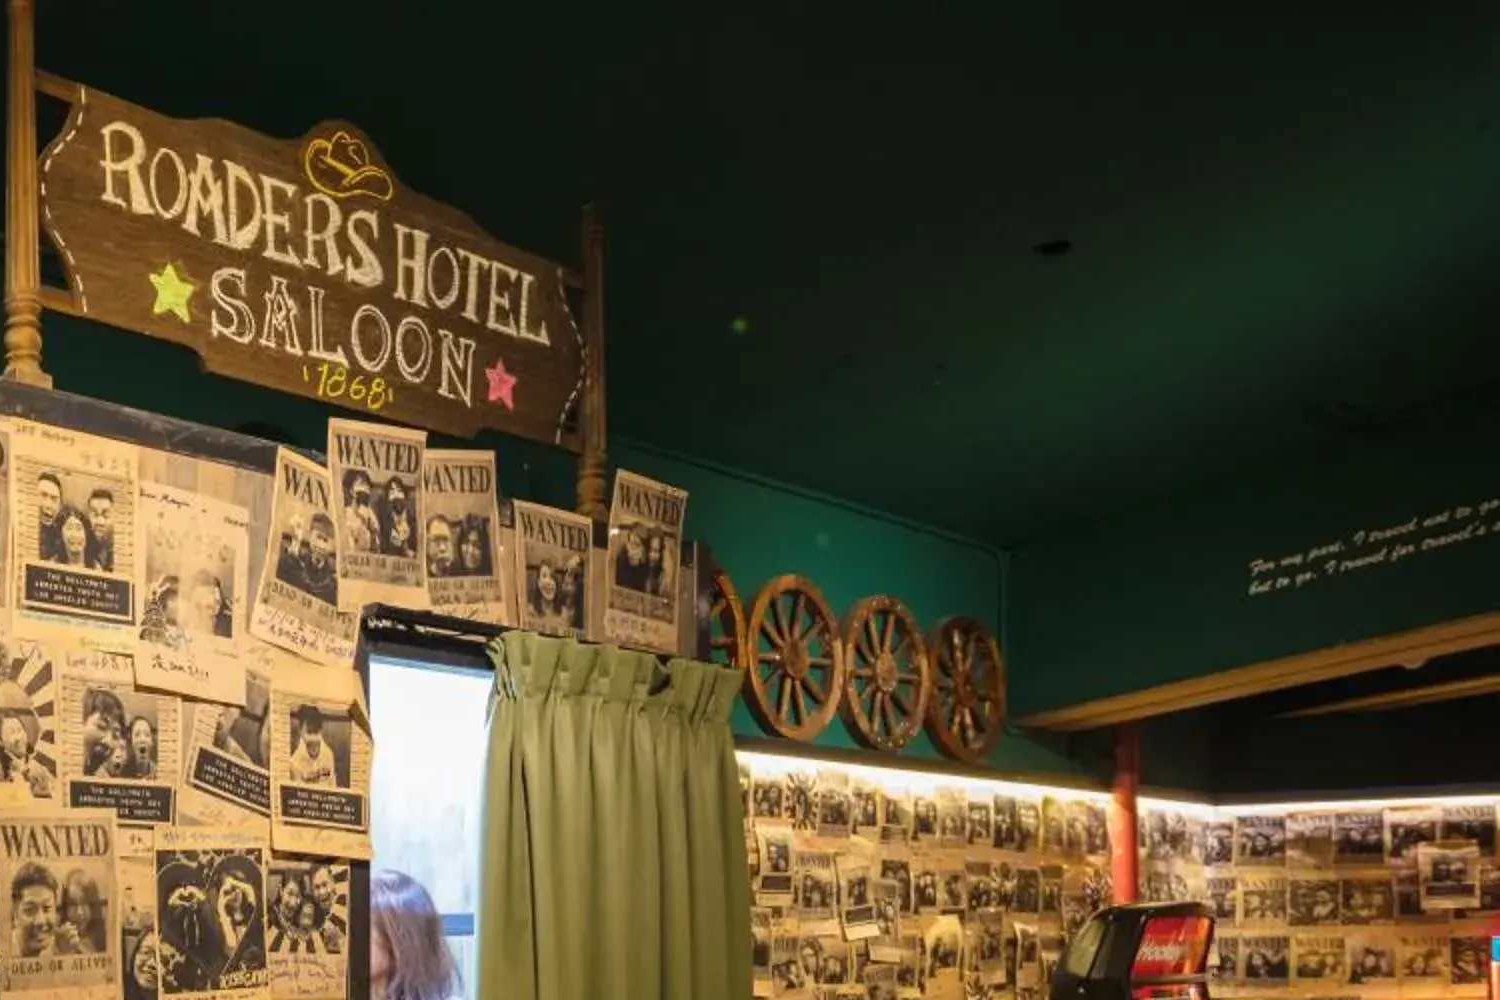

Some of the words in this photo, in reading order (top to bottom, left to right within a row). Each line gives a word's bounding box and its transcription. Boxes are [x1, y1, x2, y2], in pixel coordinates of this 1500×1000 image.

[100, 121, 384, 288] ROADERS
[394, 223, 550, 346] HOTEL
[211, 268, 477, 408] SALOON
[338, 434, 420, 473] WANTED
[619, 483, 683, 524] WANTED
[518, 513, 589, 552] WANTED
[1249, 558, 1275, 575] For
[1281, 553, 1303, 567] my
[1368, 518, 1417, 542] travel
[1422, 511, 1451, 528] not
[1455, 505, 1472, 520] to
[1248, 579, 1271, 596] but
[1276, 576, 1291, 589] to
[1340, 547, 1387, 572] travel
[1391, 542, 1415, 562] for
[1, 824, 110, 858] WANTED
[12, 961, 43, 974] DEAD
[49, 962, 66, 972] OR
